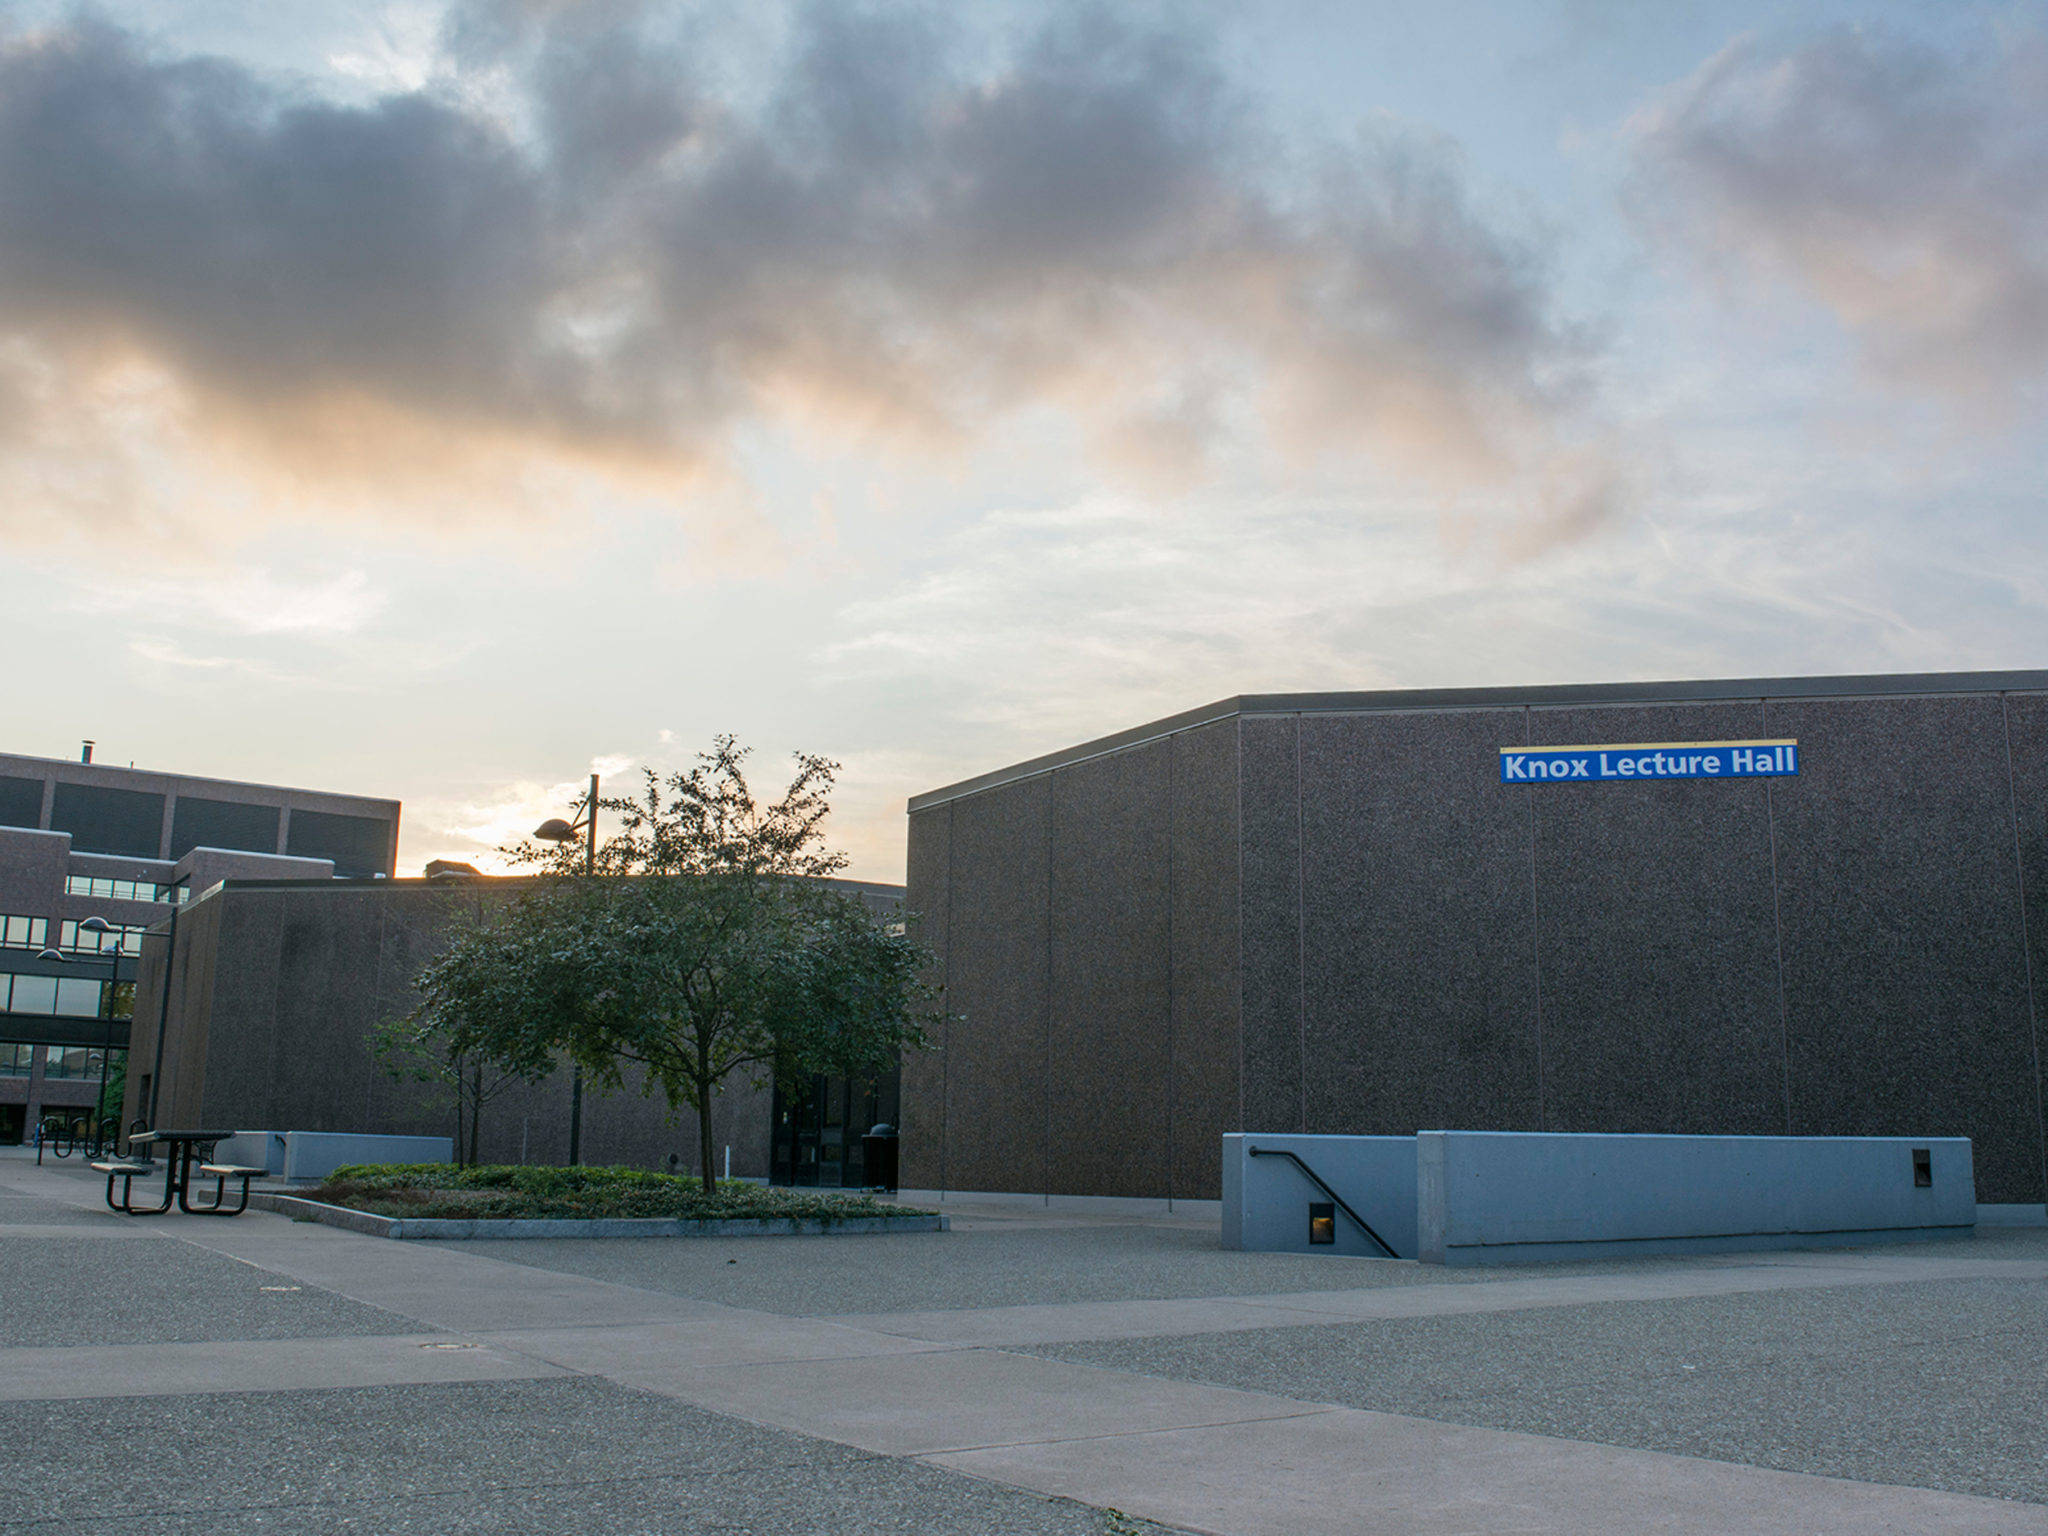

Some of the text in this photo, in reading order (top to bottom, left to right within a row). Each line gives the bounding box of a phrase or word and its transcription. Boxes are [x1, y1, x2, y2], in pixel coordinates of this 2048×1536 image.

[1505, 747, 1795, 779] Knox Lecture Hall
